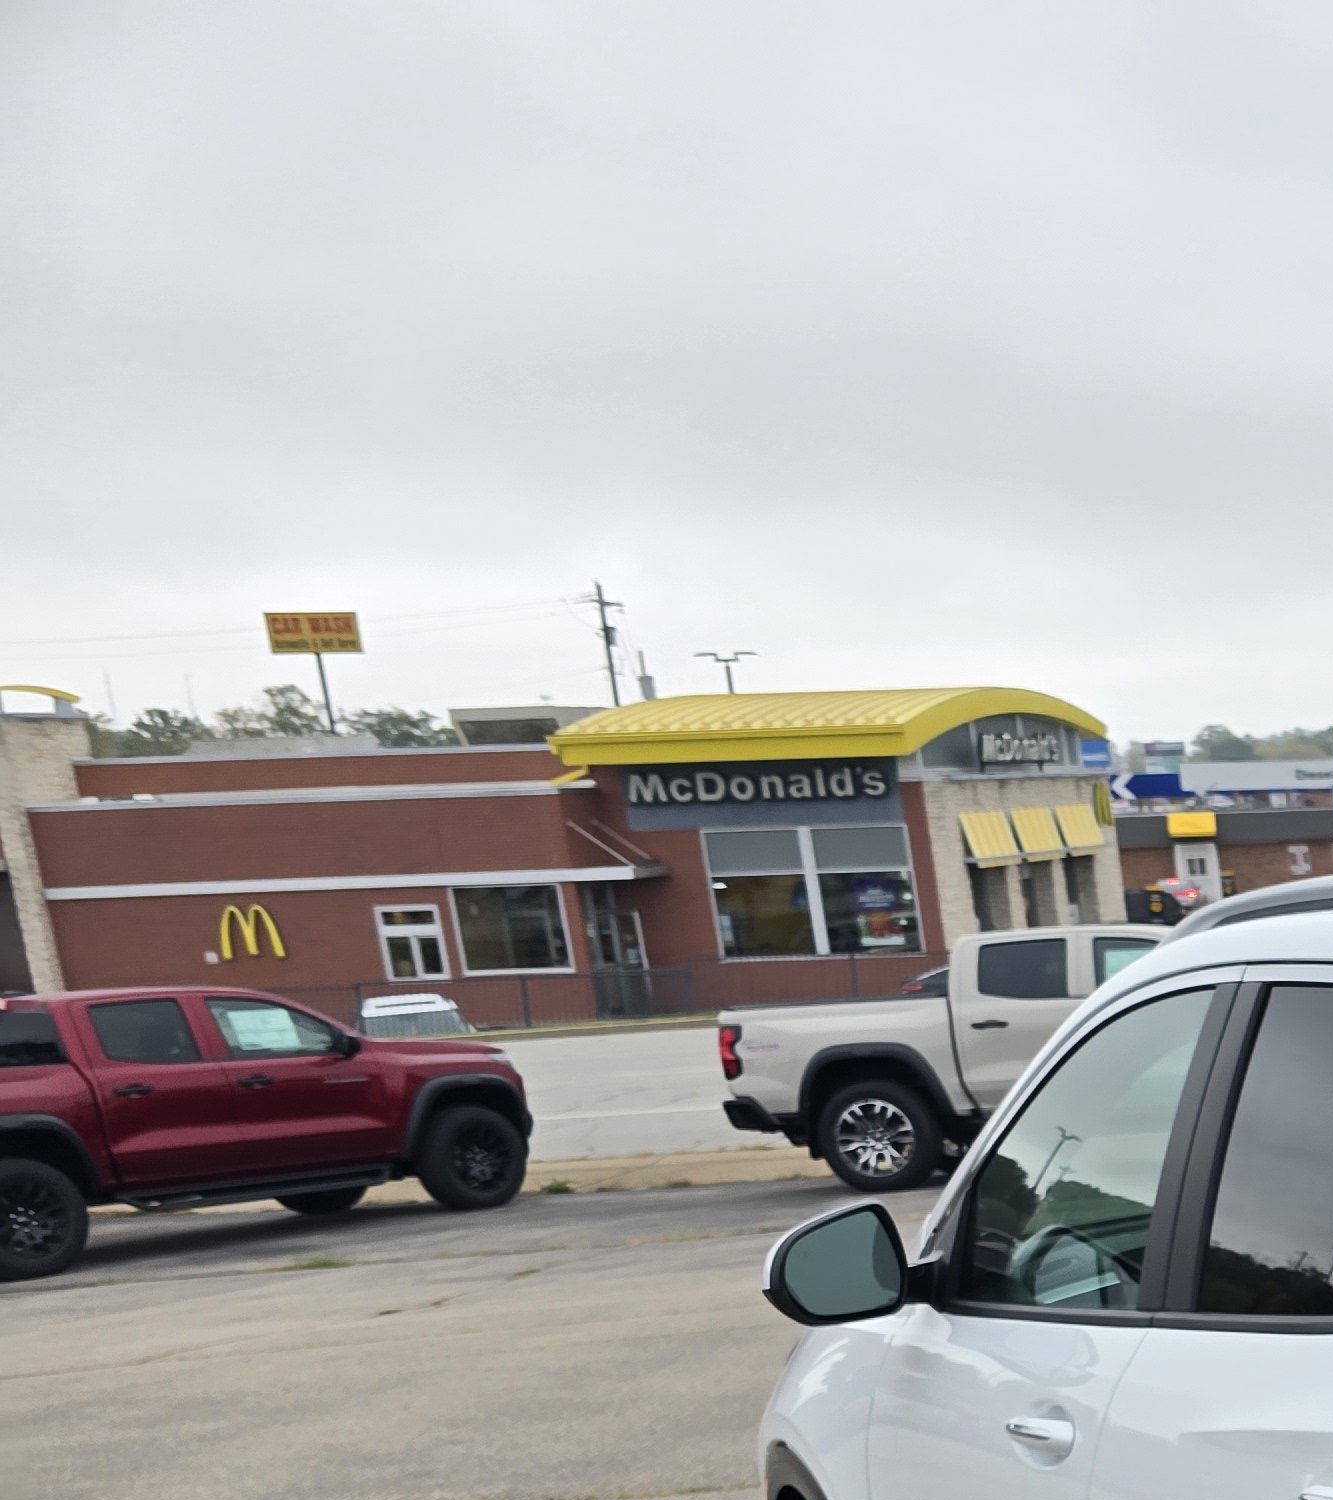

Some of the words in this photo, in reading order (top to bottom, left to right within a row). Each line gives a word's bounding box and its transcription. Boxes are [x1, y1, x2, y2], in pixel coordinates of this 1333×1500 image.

[271, 617, 302, 635] CAR
[308, 616, 353, 634] WASH
[982, 732, 1060, 762] McDonald's
[628, 767, 886, 803] McDonald's
